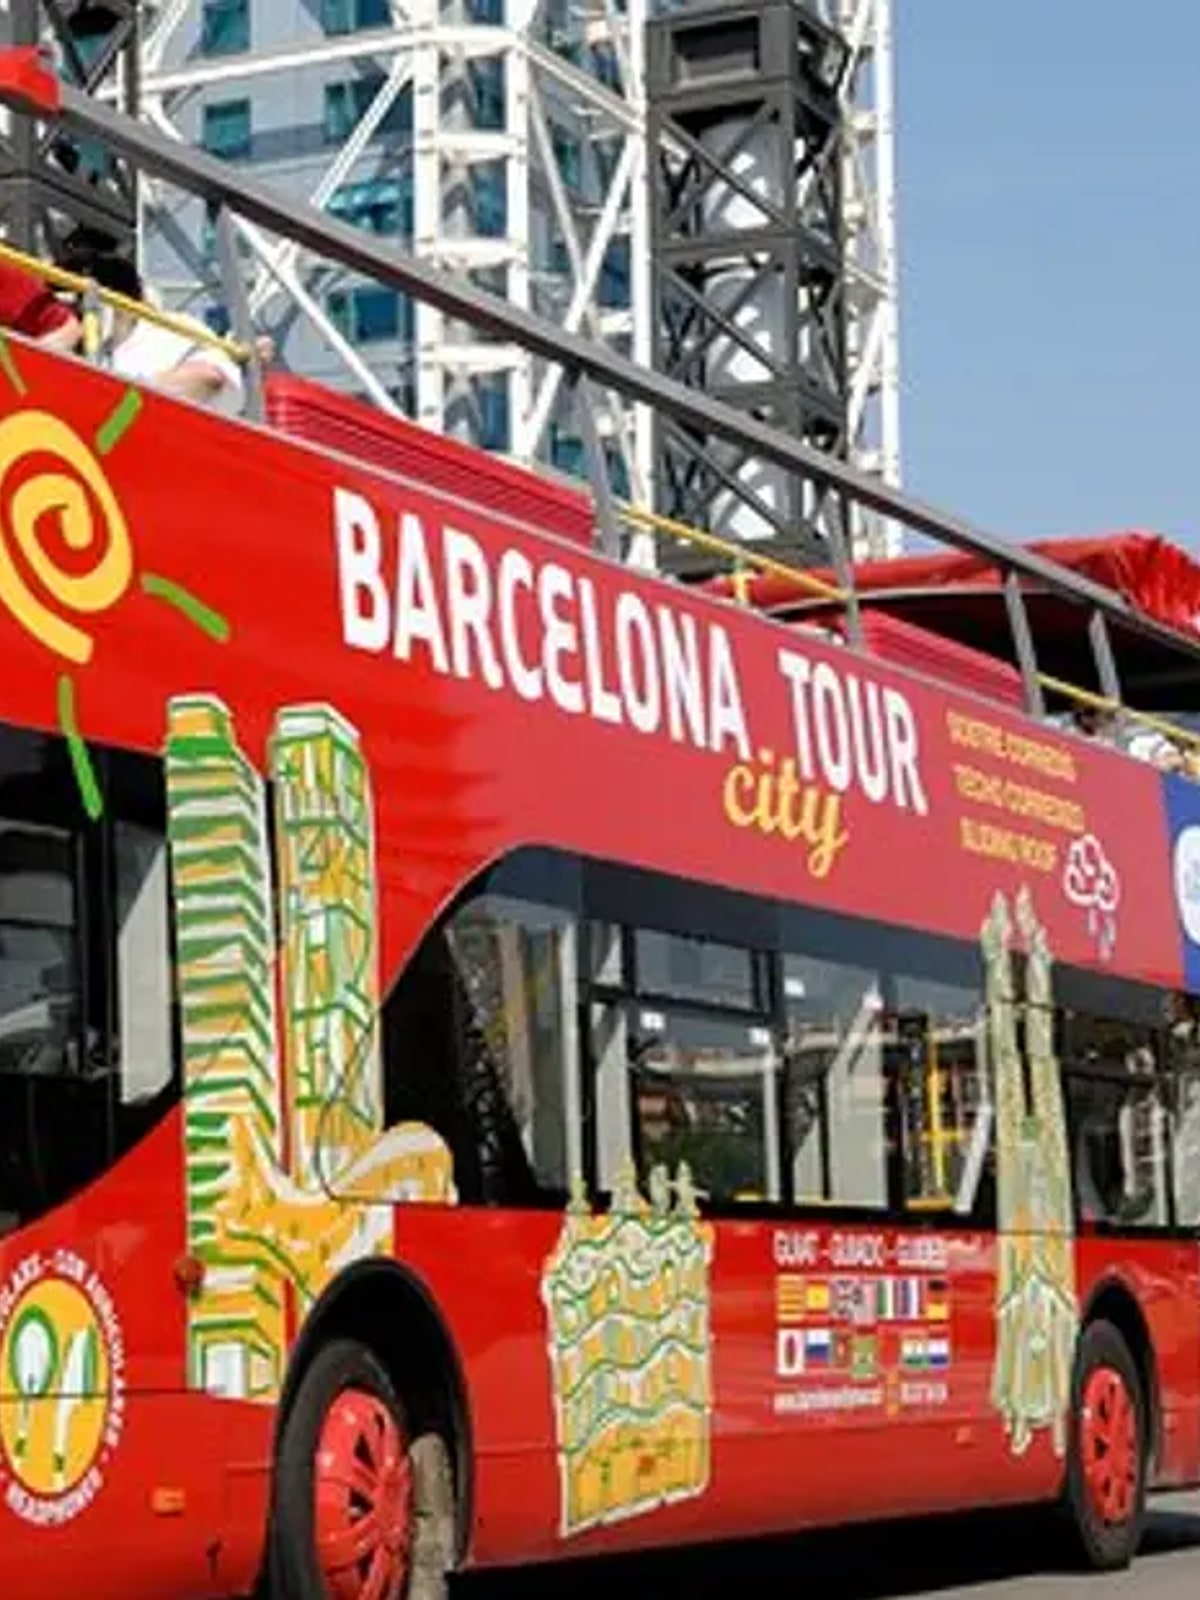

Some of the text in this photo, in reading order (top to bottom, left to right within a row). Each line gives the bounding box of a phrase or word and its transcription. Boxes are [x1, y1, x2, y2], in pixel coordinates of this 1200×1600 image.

[333, 486, 928, 815] BARCELONA TOUR
[724, 749, 849, 878] city
